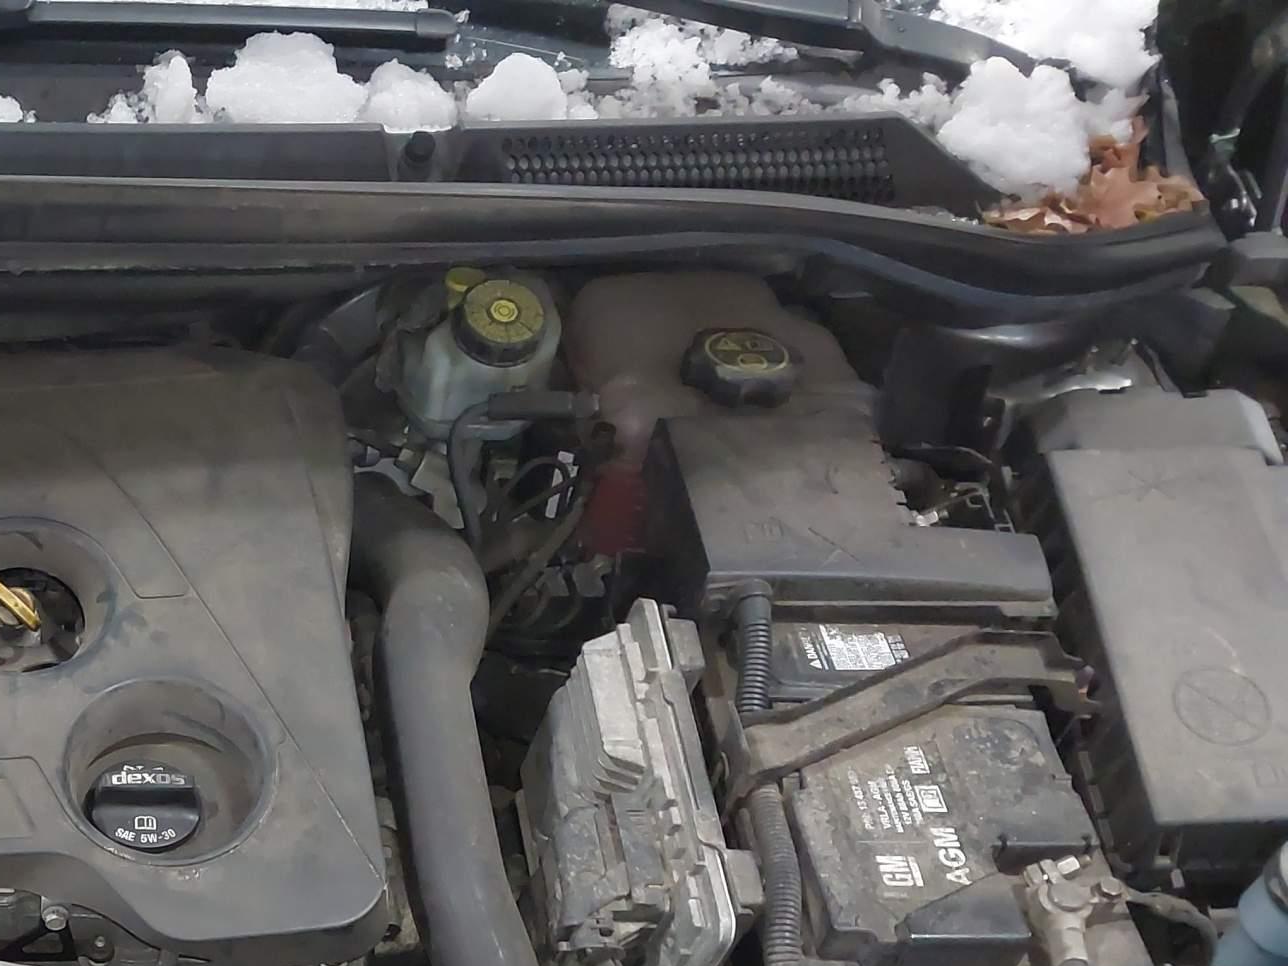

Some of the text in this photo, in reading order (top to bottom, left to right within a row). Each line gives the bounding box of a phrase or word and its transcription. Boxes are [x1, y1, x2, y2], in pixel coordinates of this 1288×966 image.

[112, 771, 185, 785] dexos
[115, 828, 176, 843] SAE 5W-30
[930, 828, 973, 886] AGM
[875, 855, 914, 887] GM
